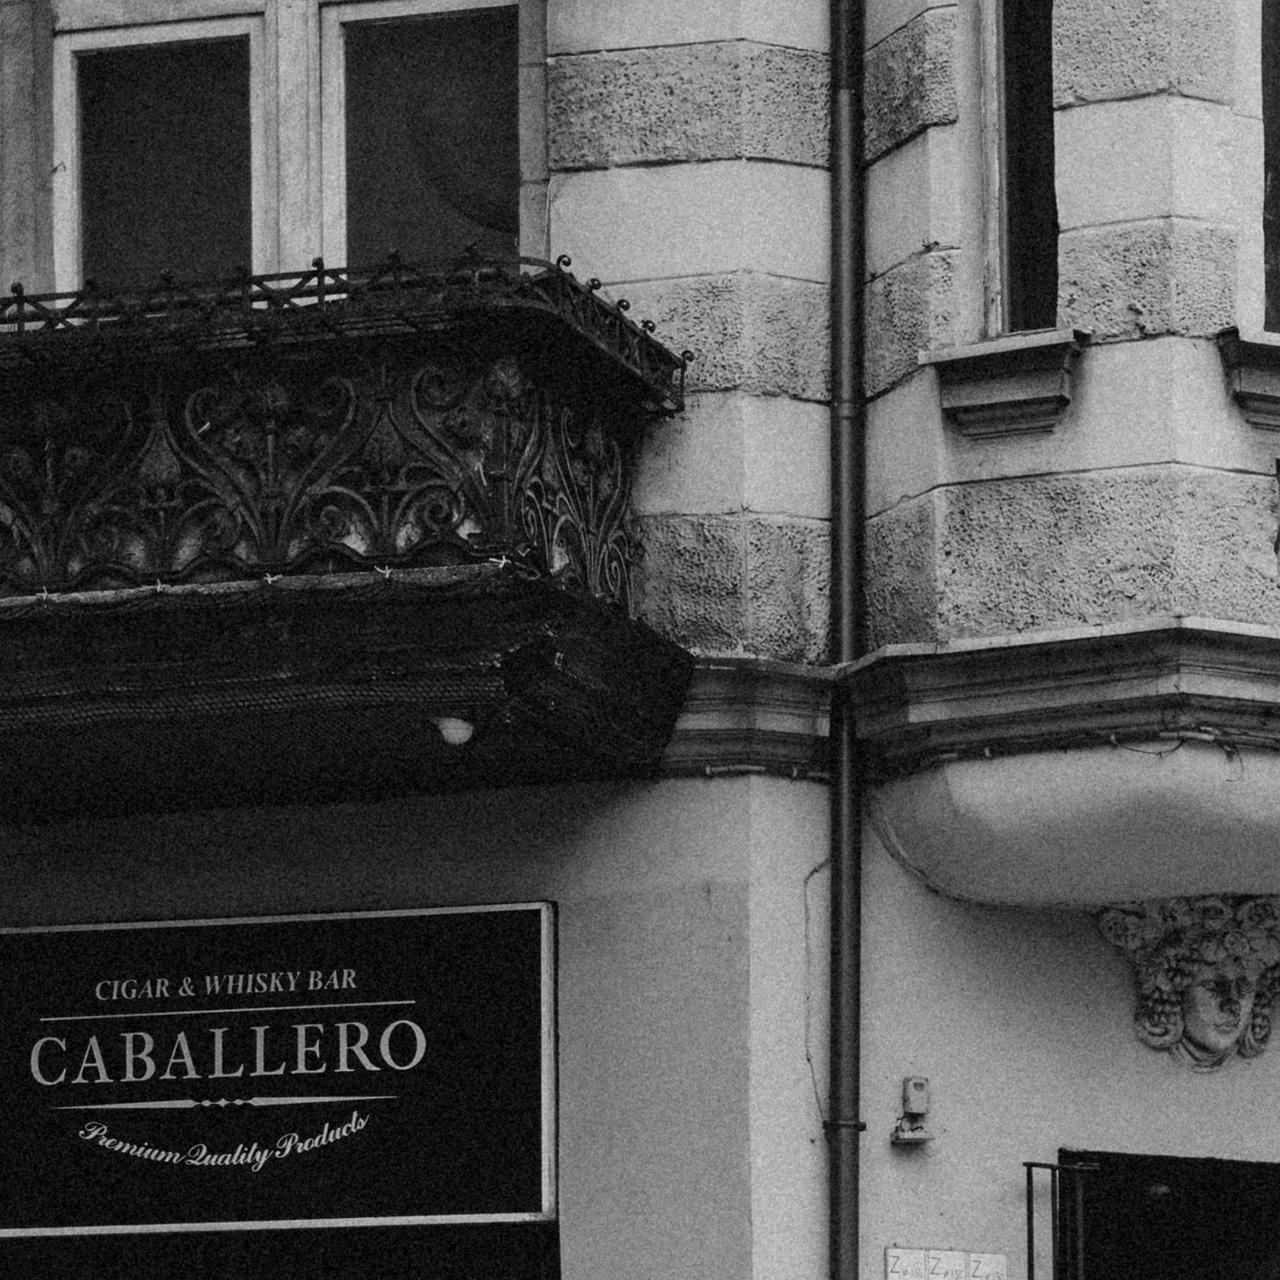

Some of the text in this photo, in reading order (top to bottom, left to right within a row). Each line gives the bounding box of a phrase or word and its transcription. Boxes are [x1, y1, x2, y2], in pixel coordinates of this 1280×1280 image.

[95, 968, 358, 1000] CIGAR & WHISKY BAR
[30, 1019, 427, 1087] CABALLERO
[79, 1110, 370, 1173] Premium Quality Products
